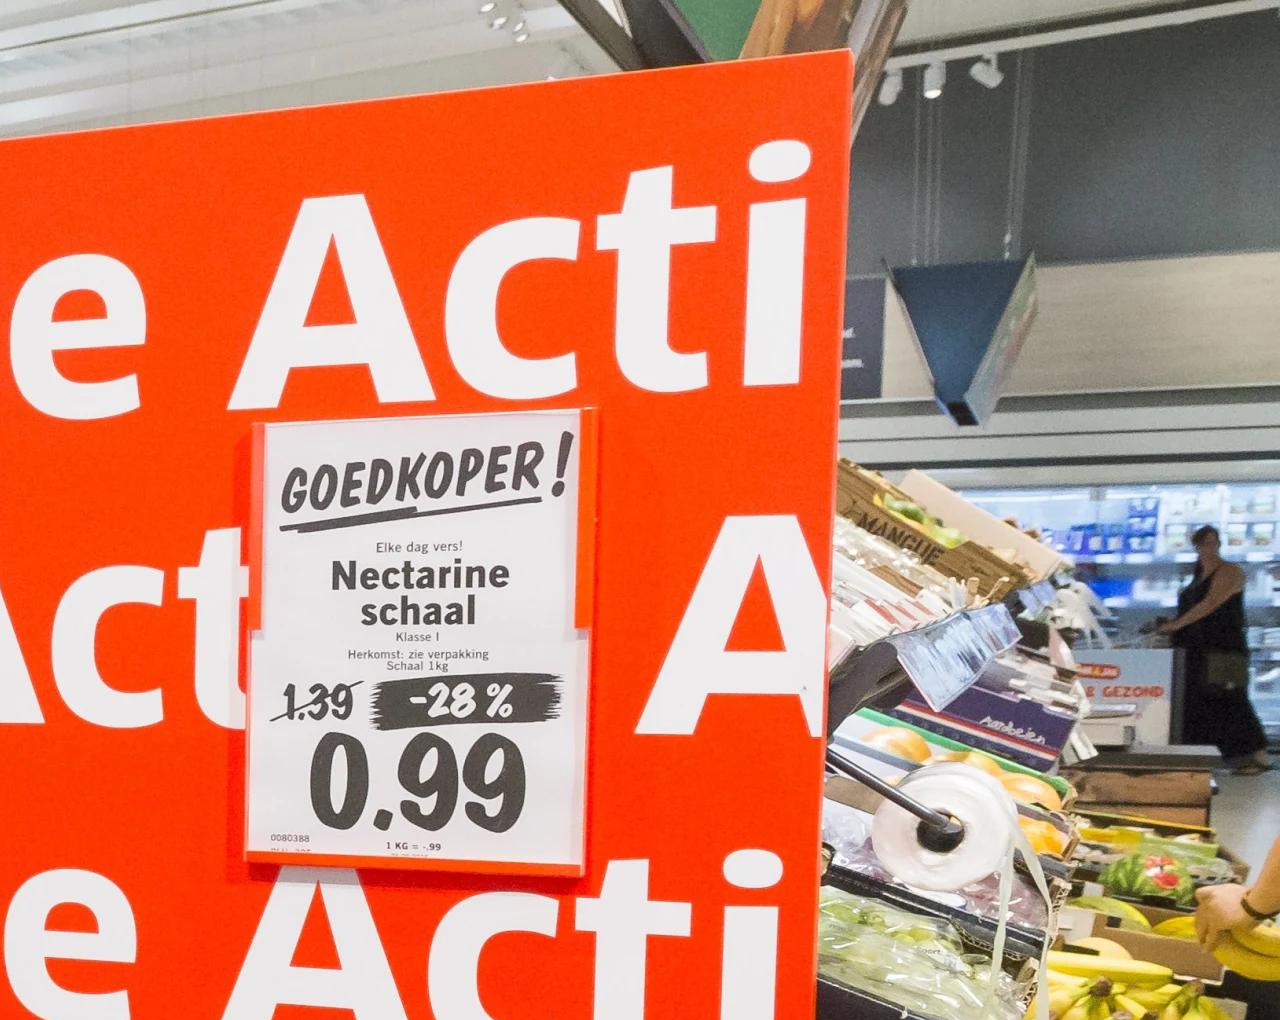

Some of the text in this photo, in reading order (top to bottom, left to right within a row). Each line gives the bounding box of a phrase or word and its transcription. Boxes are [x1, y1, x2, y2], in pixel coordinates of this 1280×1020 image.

[228, 139, 810, 410] Acti
[280, 431, 574, 514] GOEDKOPER!
[376, 540, 463, 555] Elke dag vers!
[332, 558, 510, 590] Nectarine
[361, 594, 475, 626] schaal
[396, 632, 432, 642] Klasse
[348, 649, 489, 661] Herkomst: zie verpakking
[387, 661, 449, 673] Schaal 1kg
[280, 682, 513, 721] 1.39 -28 %
[309, 732, 526, 833] 0.99
[270, 834, 310, 843] 0080388
[386, 841, 441, 851] 1 KG -.99
